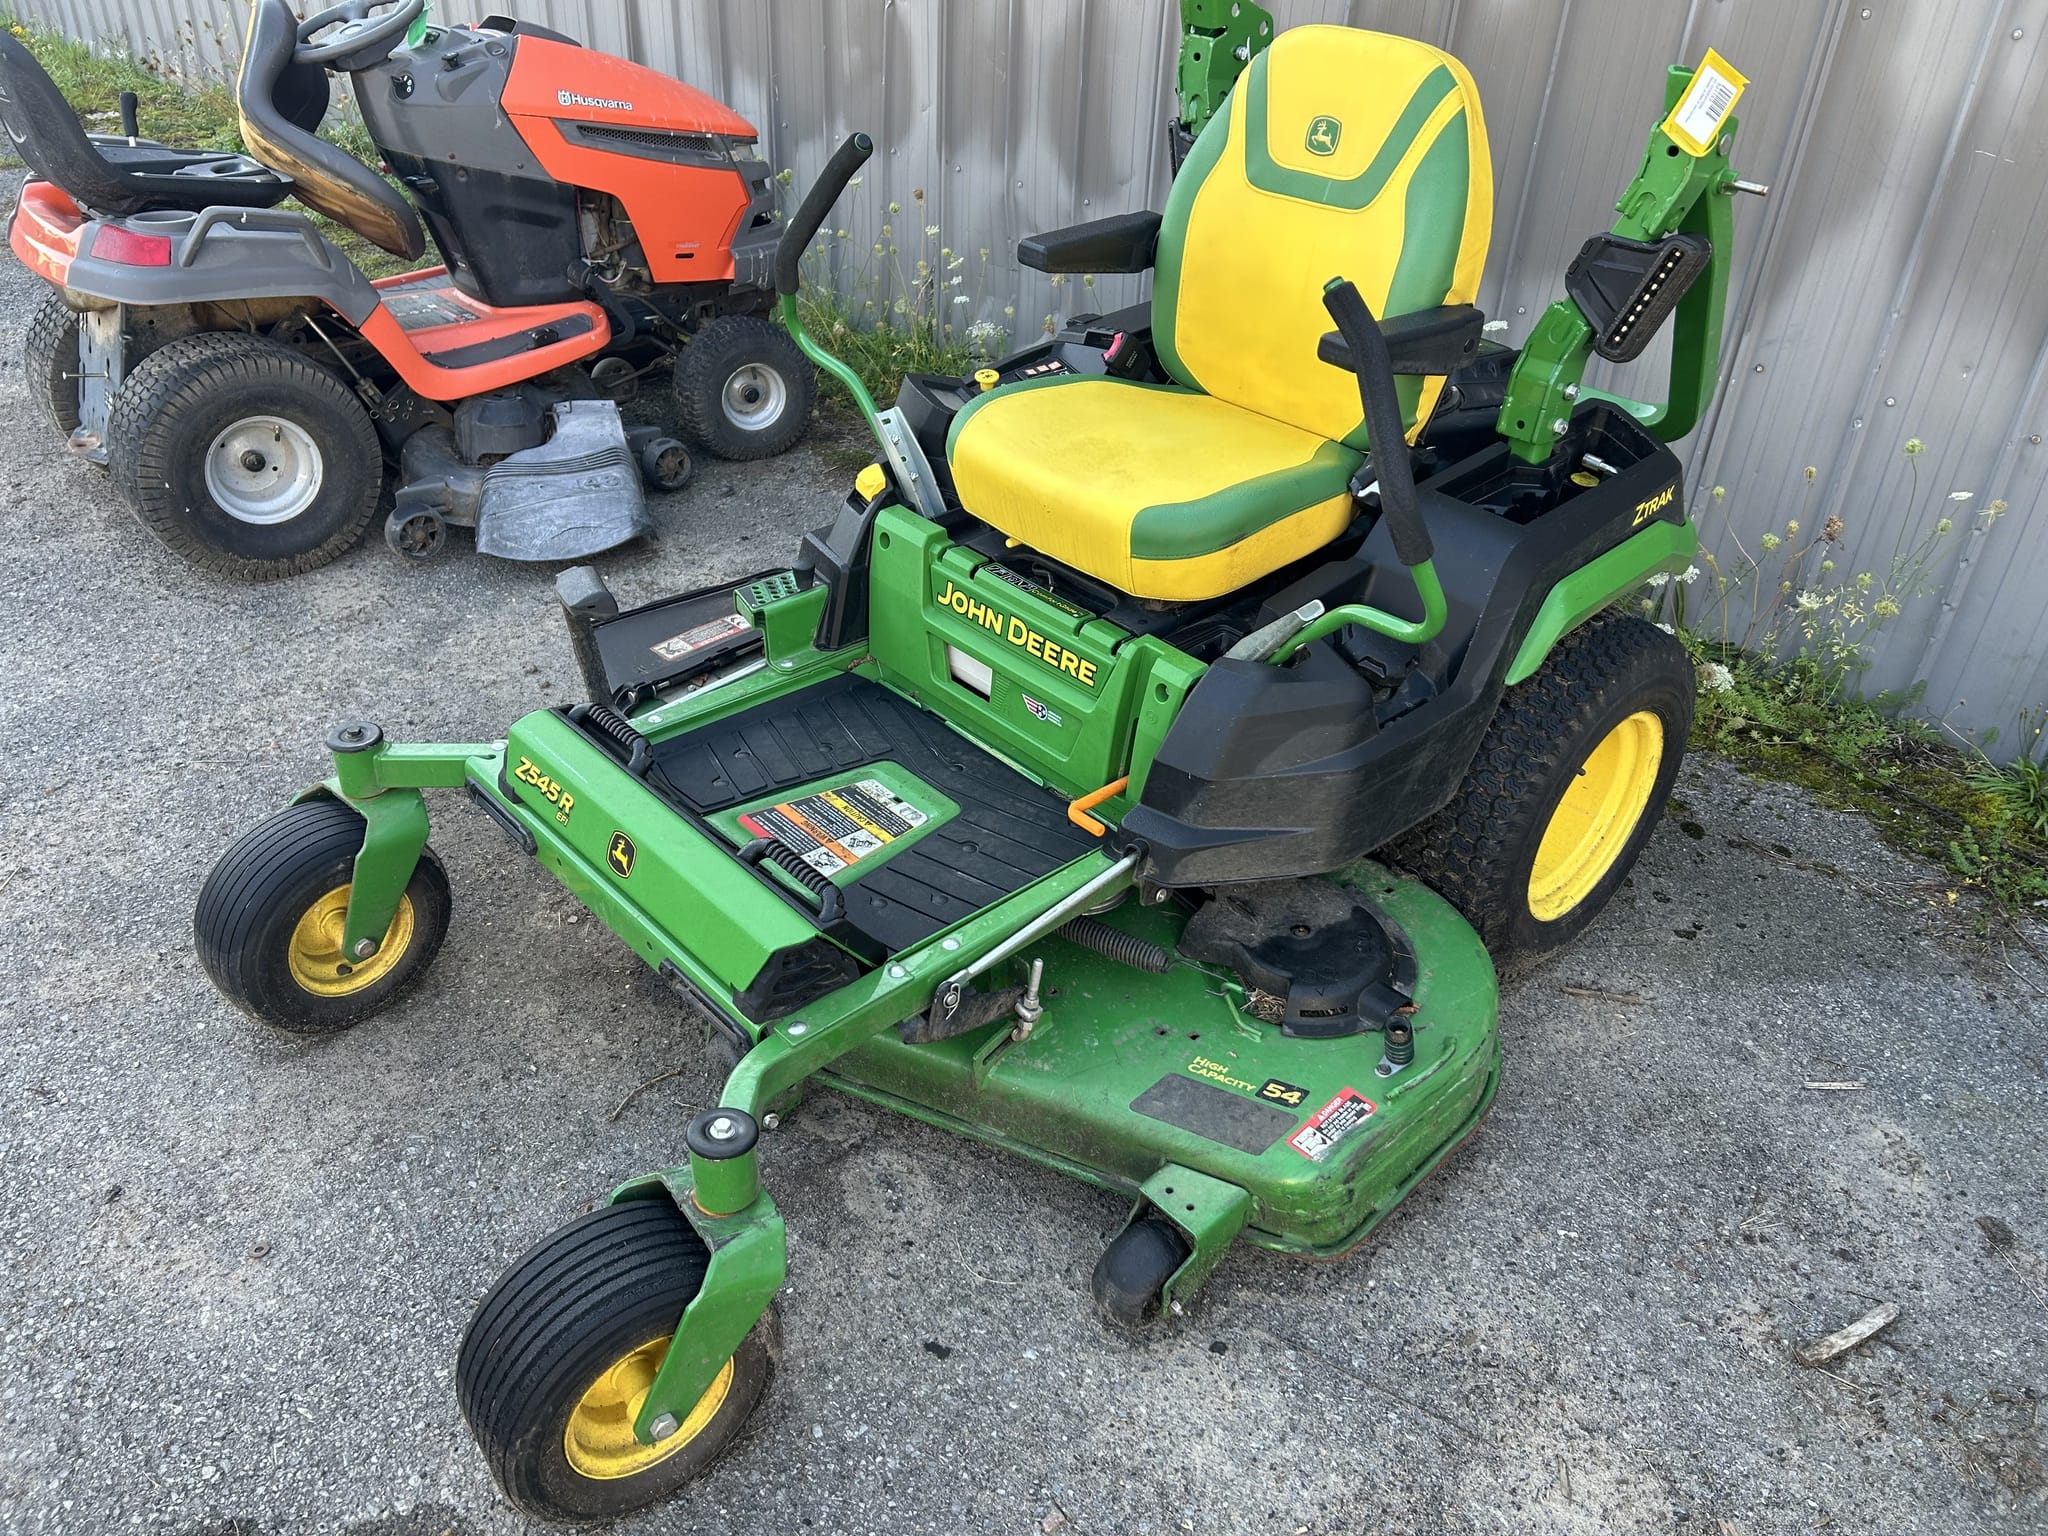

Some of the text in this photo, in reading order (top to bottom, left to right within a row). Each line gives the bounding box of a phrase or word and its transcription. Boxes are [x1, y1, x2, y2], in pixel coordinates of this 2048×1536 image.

[571, 93, 633, 111] Husqvarna
[1631, 484, 1676, 528] ZTRAK
[937, 581, 1004, 636] JOHN
[1007, 616, 1098, 688] DEERE
[514, 755, 575, 815] Z545 R
[555, 811, 570, 827] EFI
[1192, 1056, 1229, 1075] HIGH
[1187, 1063, 1257, 1092] CAPACITY
[1262, 1082, 1302, 1105] 54
[1321, 1096, 1343, 1117] DANGER
